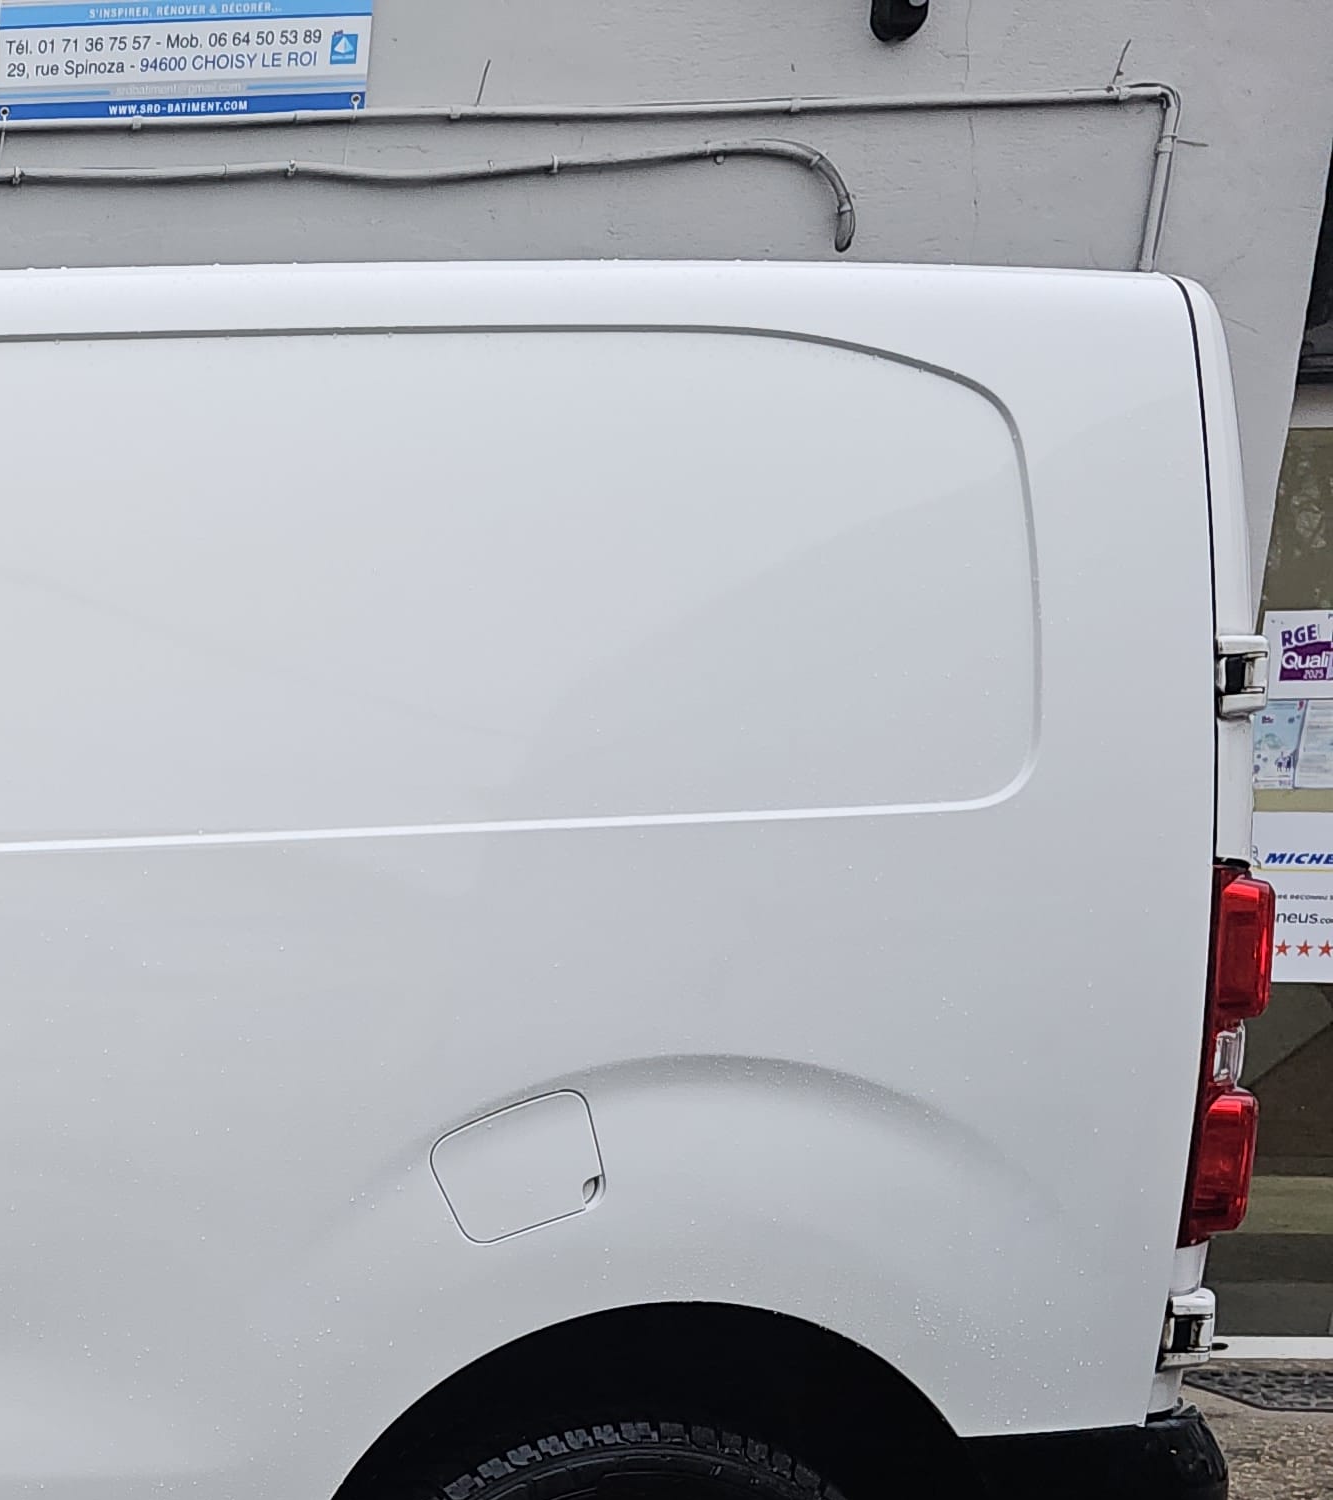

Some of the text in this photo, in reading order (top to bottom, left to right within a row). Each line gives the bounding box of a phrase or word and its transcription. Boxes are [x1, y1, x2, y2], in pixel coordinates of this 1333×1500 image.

[156, 3, 205, 17] RÉNOVER
[209, 4, 218, 14] &
[6, 40, 33, 55] Tél.
[38, 39, 55, 54] 01
[62, 38, 79, 53] 71
[84, 37, 104, 52] 36
[109, 36, 128, 51] 75
[132, 35, 151, 50] 57
[166, 33, 203, 49] Mob.
[208, 32, 228, 48] 06
[232, 31, 251, 46] 64
[255, 30, 275, 46] 50
[279, 29, 299, 45] 53
[303, 28, 323, 44] 89
[7, 62, 31, 79] 29,
[35, 63, 59, 76] rue
[64, 59, 125, 78] Spinoza
[139, 57, 187, 73] 94600
[192, 53, 259, 70] CHOISY
[261, 52, 282, 68] LE
[287, 51, 317, 67] ROI
[1281, 623, 1318, 648] RGE
